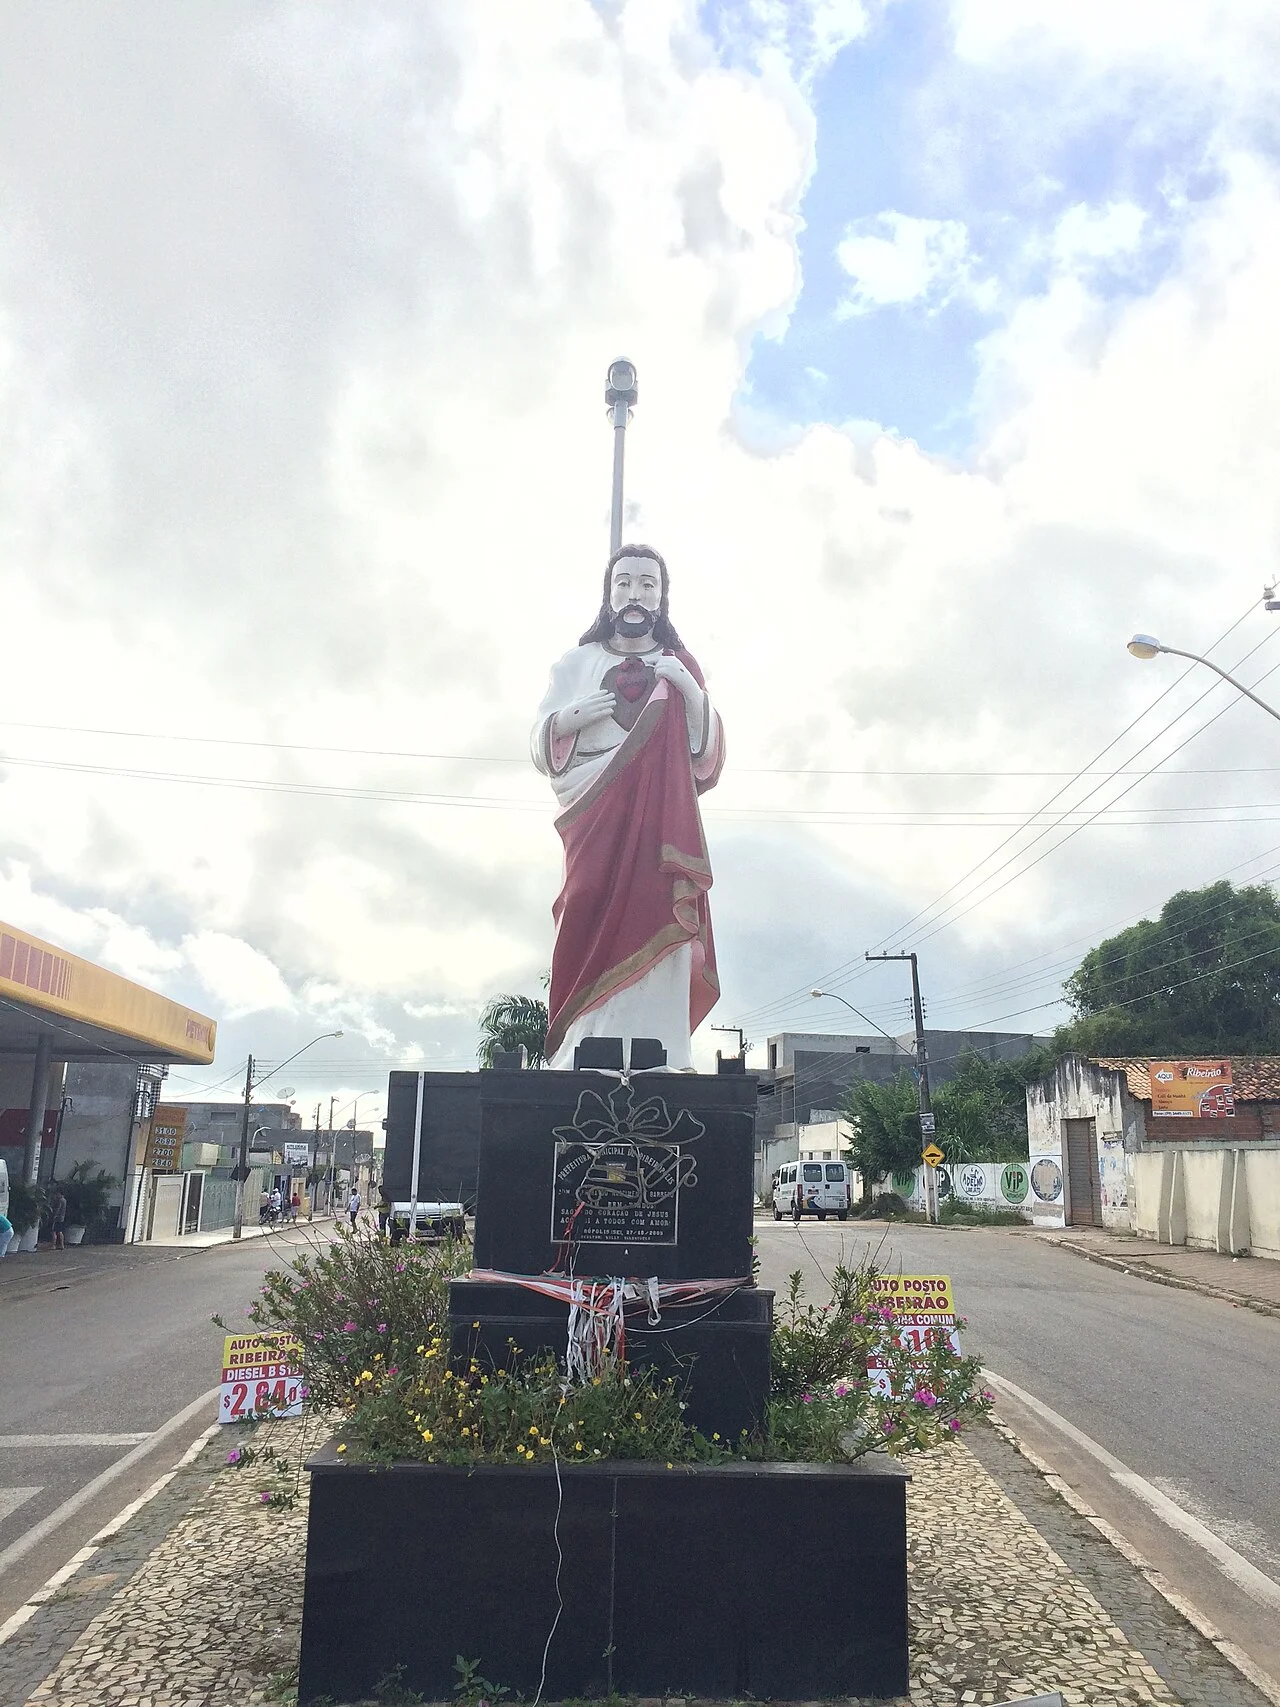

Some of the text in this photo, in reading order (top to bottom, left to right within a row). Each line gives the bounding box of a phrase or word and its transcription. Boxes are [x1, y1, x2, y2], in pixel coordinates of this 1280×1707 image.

[1186, 1067, 1221, 1078] Ribeirão
[153, 1148, 173, 1156] 2700
[557, 1153, 592, 1181] PREFEITURA
[647, 1210, 669, 1218] JESUS
[873, 1279, 947, 1292] UTO POSTO
[884, 1292, 949, 1310] BEIRÃO
[230, 1335, 299, 1351] AUTO OSTO
[226, 1367, 266, 1381] DIESEL
[268, 1365, 276, 1377] B
